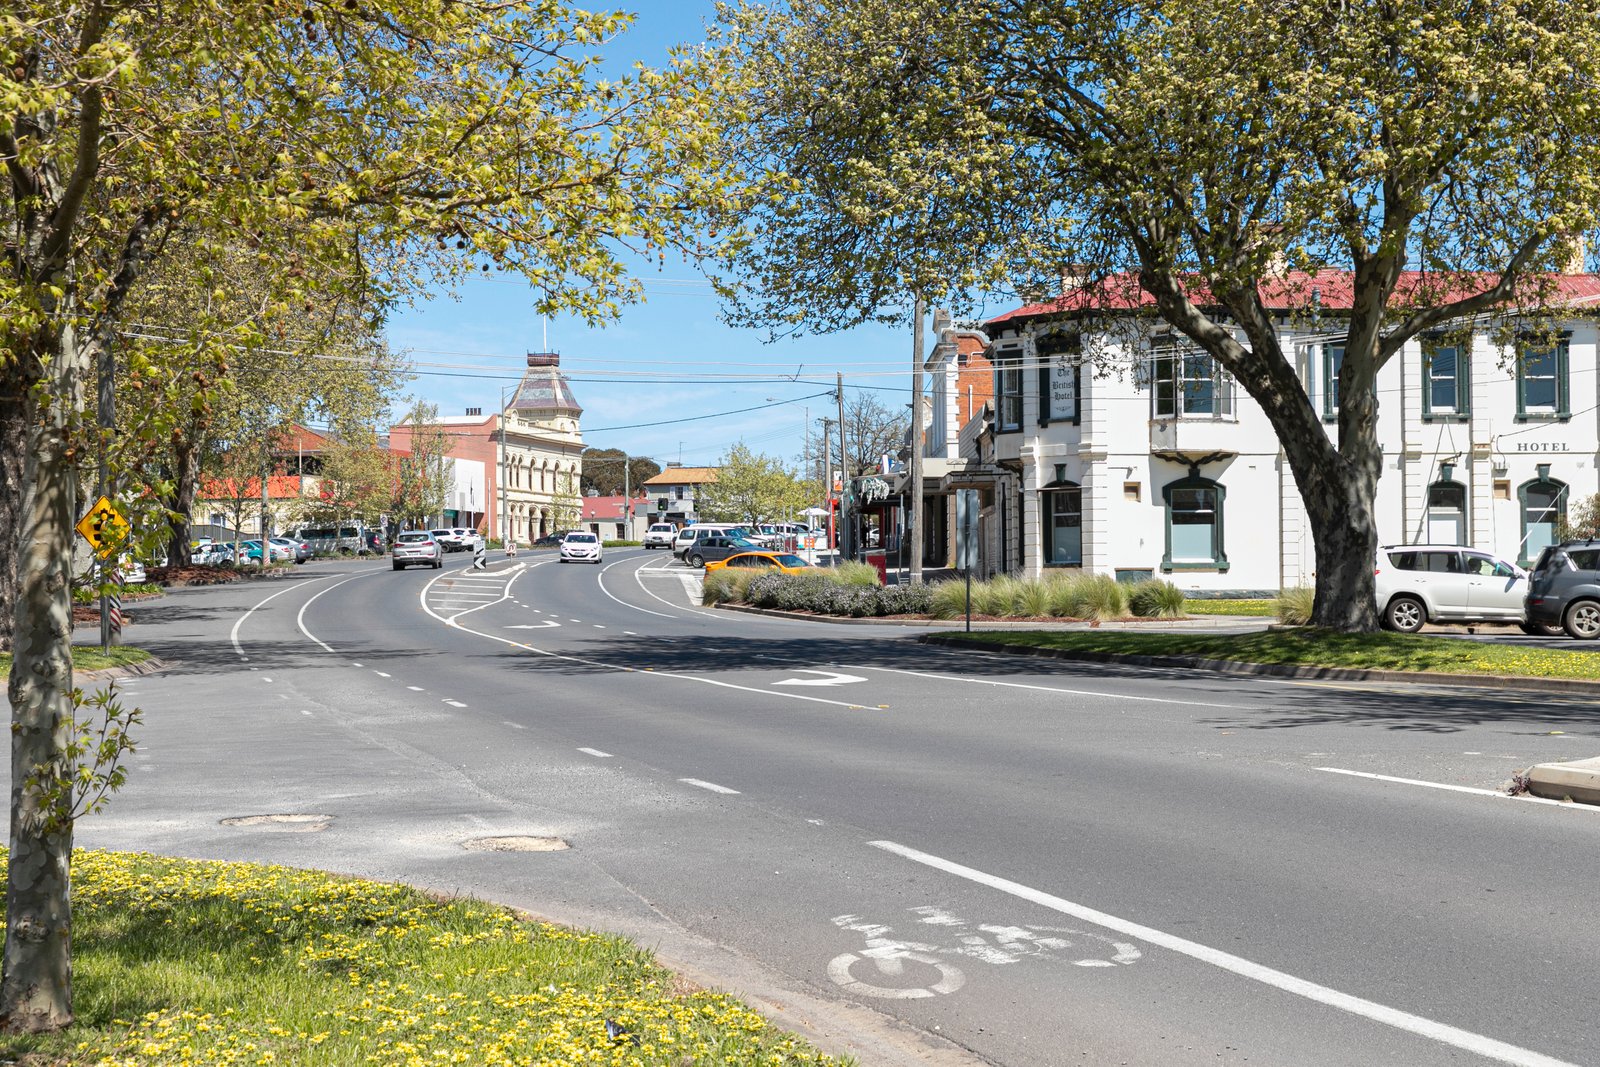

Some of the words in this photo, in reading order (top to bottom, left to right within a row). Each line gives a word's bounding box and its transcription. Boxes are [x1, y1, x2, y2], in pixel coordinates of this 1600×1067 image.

[1057, 367, 1070, 377] The
[1054, 391, 1072, 401] Hotel
[1517, 442, 1570, 451] HOTEL
